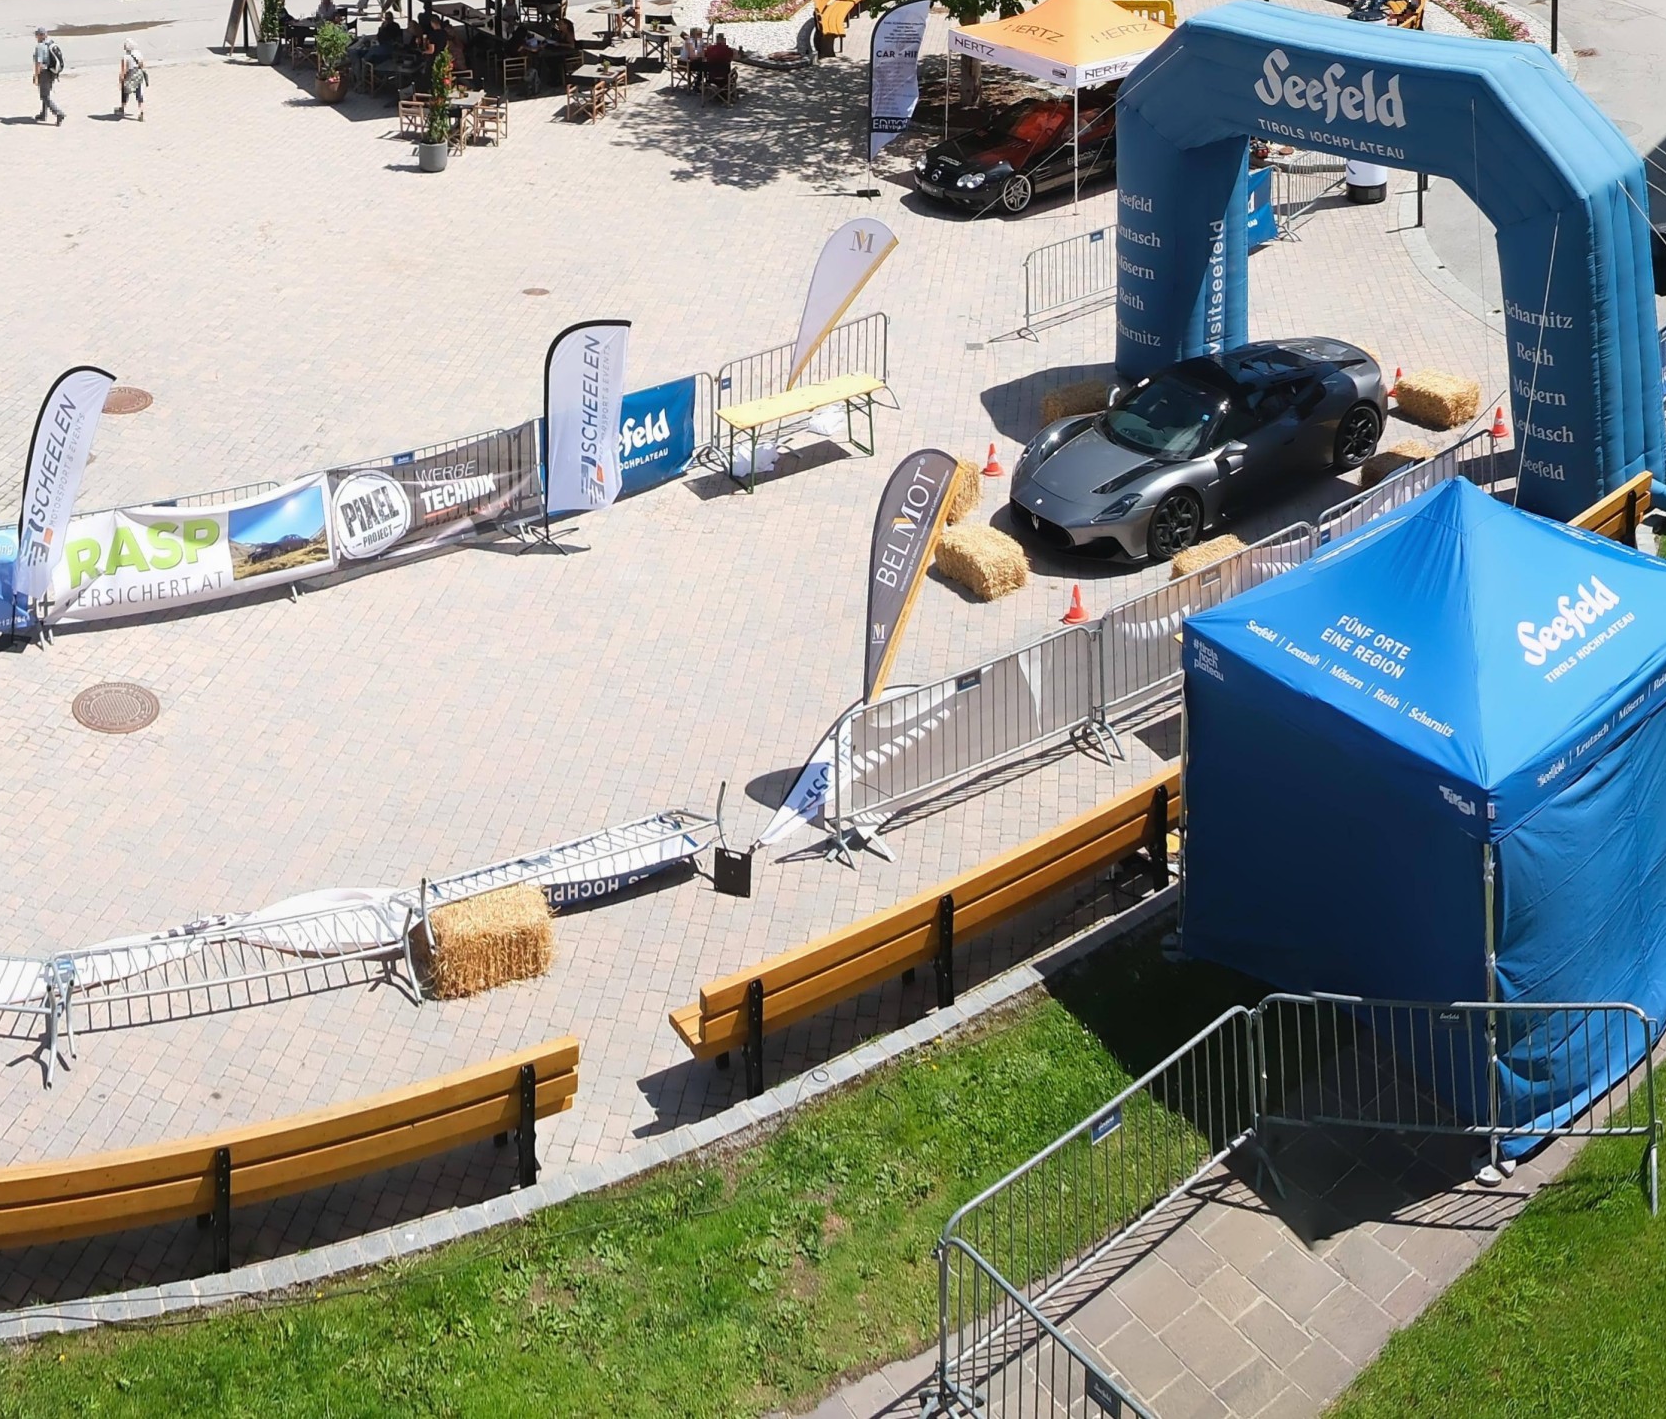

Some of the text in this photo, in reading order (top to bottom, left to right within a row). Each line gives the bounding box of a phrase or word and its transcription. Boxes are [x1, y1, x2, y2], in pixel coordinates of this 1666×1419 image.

[876, 50, 895, 58] CAR
[1254, 48, 1407, 128] Seefeld
[1257, 118, 1306, 140] TIROLS
[1119, 188, 1152, 213] Seefeld
[1119, 286, 1144, 311] Reith
[1207, 219, 1226, 355] visitseefeld
[1505, 299, 1573, 329] Scharnitz
[1516, 342, 1555, 366] Reith
[1513, 375, 1566, 406] Mösern
[1513, 411, 1574, 443] Leutasch
[30, 393, 77, 521] SCHEELEN
[416, 460, 476, 483] WERBE
[421, 473, 496, 514] TECHNIK
[341, 485, 400, 538] PIXEL
[876, 466, 935, 588] BELMOT
[65, 518, 220, 589] RASP
[363, 530, 394, 548] PROJECT
[66, 571, 223, 608] ERSICHERT.AT
[1336, 615, 1412, 660] FÜNF ORTE
[1517, 574, 1620, 667] Seefeld
[1199, 650, 1218, 668] hoch
[1320, 627, 1406, 679] EINE REGION
[1543, 611, 1636, 684] TIROLS HOCHPLATEAU
[1194, 658, 1224, 682] plateau
[1245, 619, 1278, 643] Seefeld
[1329, 664, 1364, 690] Mösern
[1373, 687, 1400, 710] Reith
[1408, 706, 1455, 738] Scharnitz
[1575, 723, 1609, 757] Leutasch
[1618, 693, 1645, 722] Mösern
[1439, 784, 1476, 816] Tirol
[542, 878, 620, 902] HOCHPL
